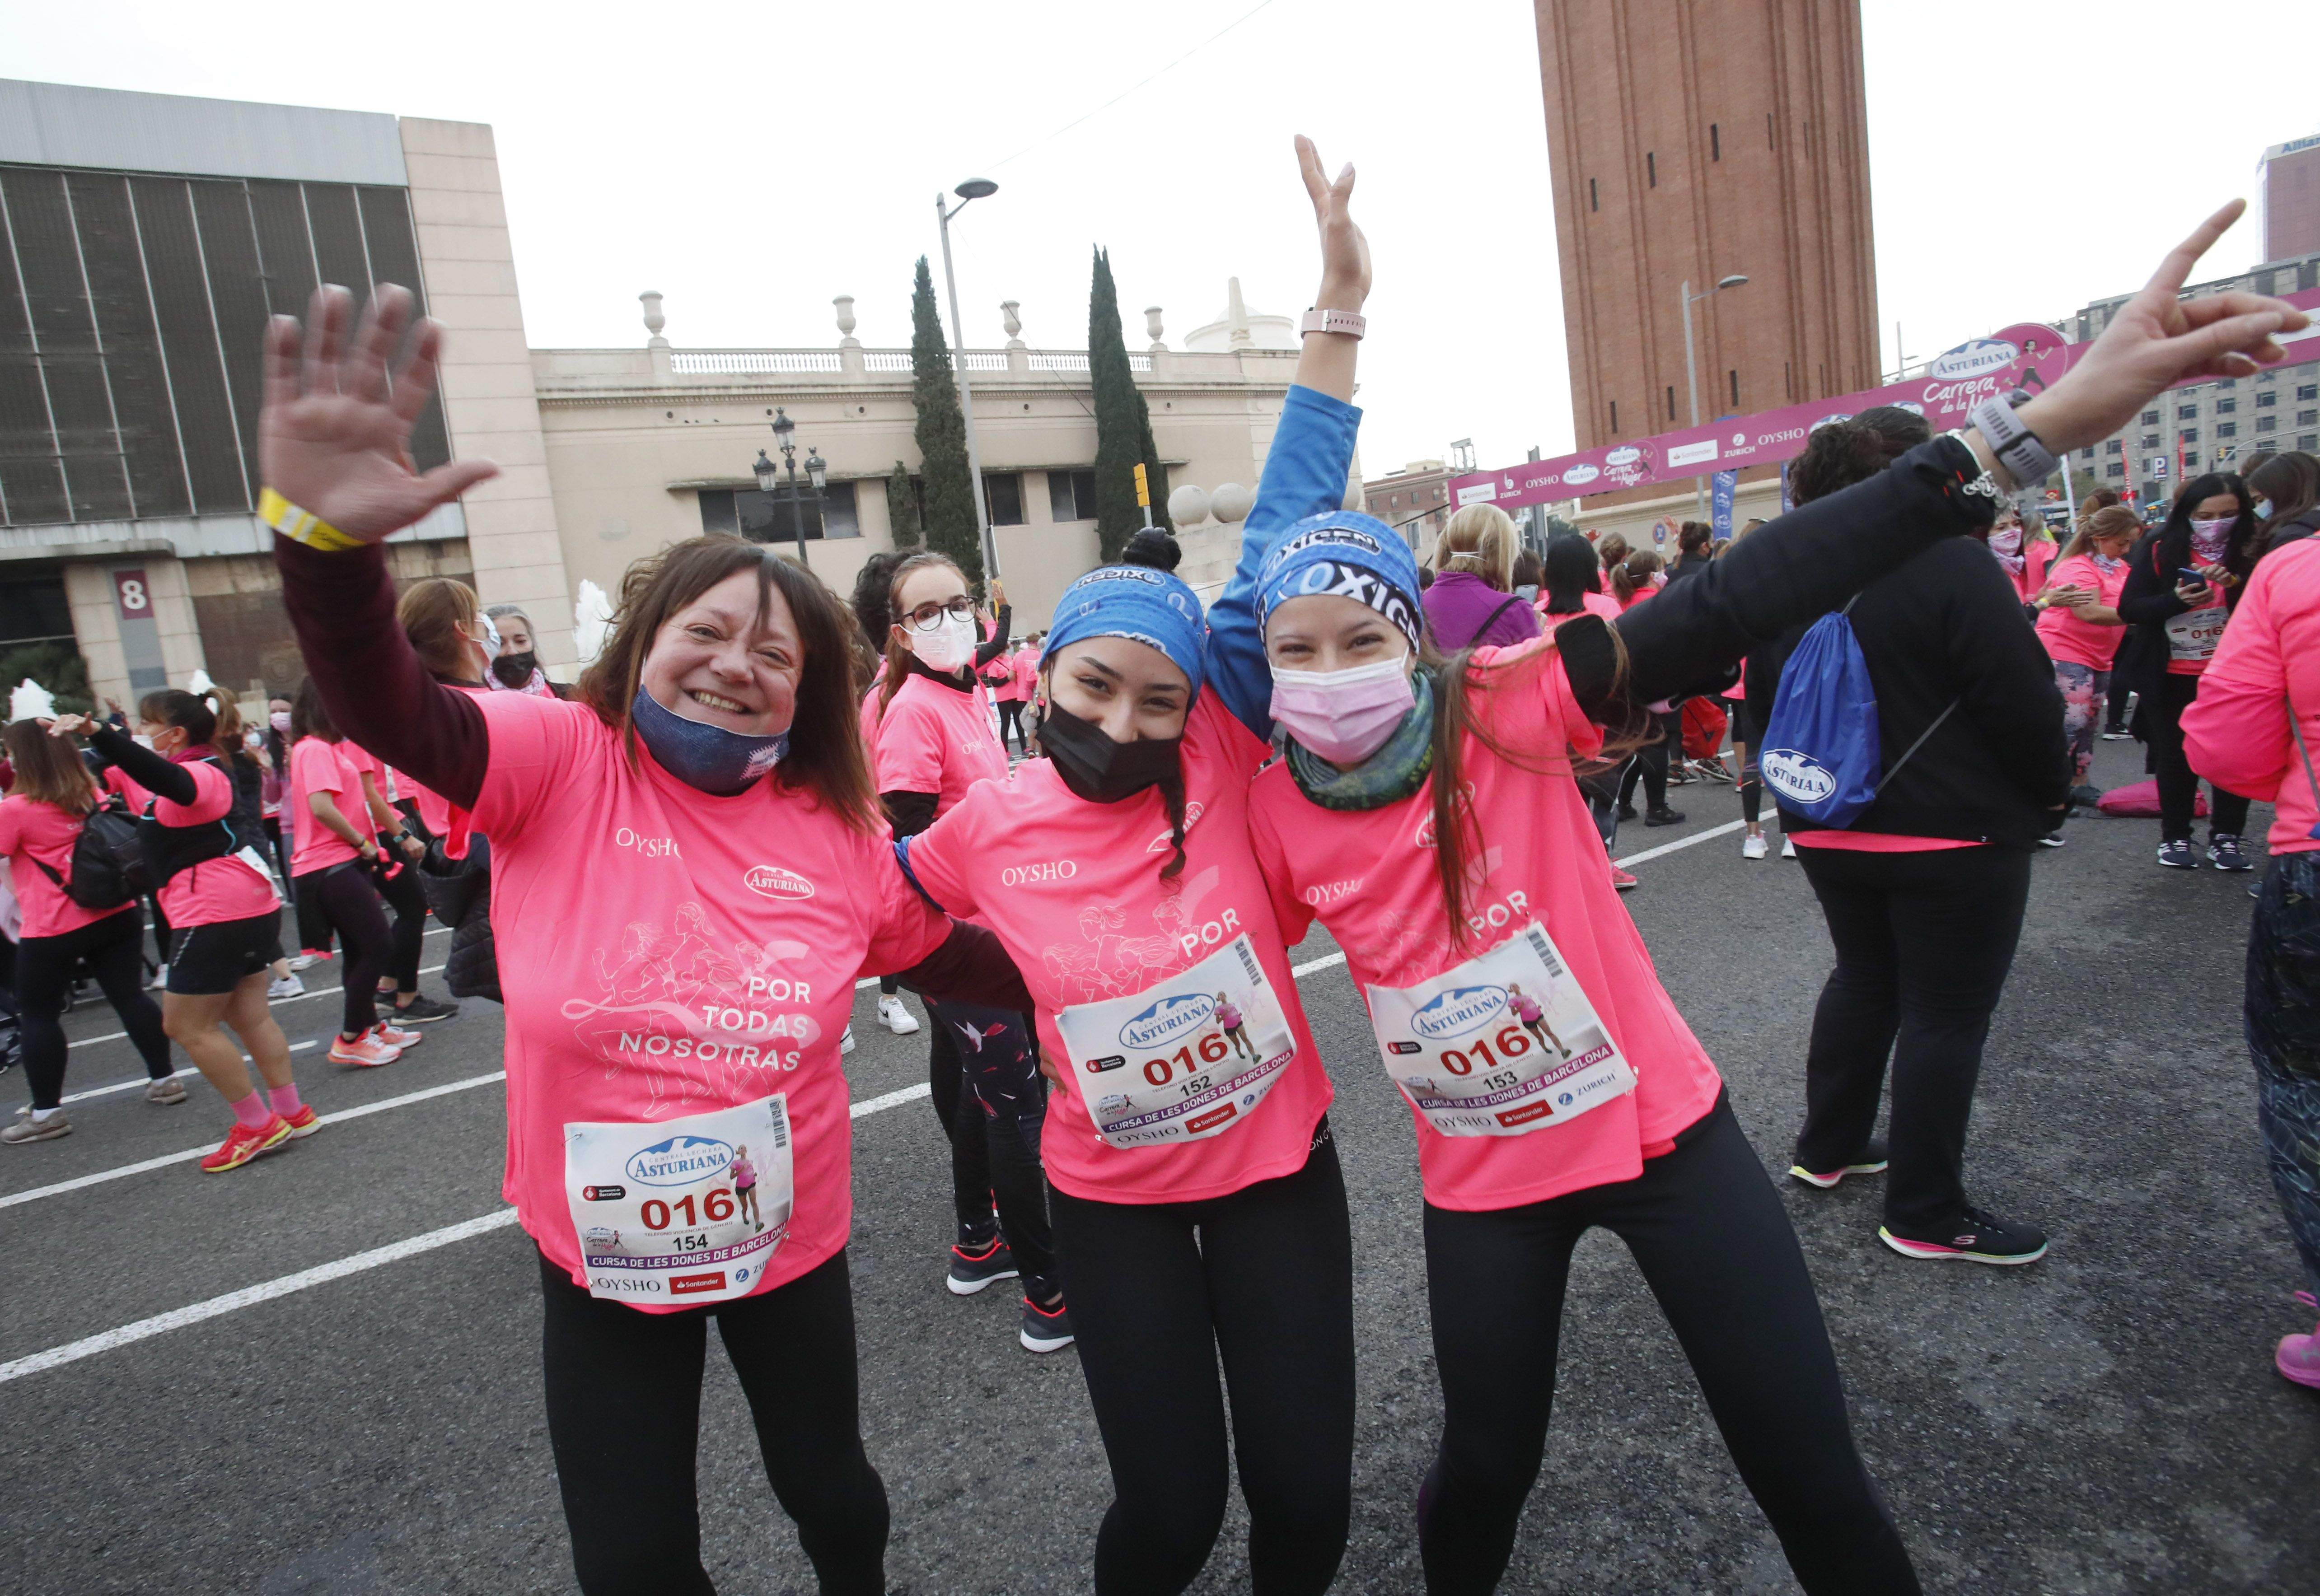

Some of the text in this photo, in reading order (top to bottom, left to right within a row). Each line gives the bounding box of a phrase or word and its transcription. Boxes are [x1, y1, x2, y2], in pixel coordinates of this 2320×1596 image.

[1938, 351, 2011, 374] ASTURIANA
[1923, 377, 1995, 403] Carrera
[1941, 401, 1953, 414] de
[1956, 398, 1967, 410] la
[1759, 428, 1805, 445] OYSHO
[1681, 448, 1712, 458] Santander
[1724, 446, 1755, 458] ZURICH
[1526, 475, 1559, 488] OYSHO
[1500, 490, 1521, 499] ZURICH
[121, 579, 147, 610] 8
[750, 872, 811, 894] ASTURIANA
[1002, 859, 1077, 887] OYSHO
[1469, 890, 1528, 940] POR
[1180, 907, 1241, 958] POR
[748, 976, 811, 1003] POR
[702, 1006, 808, 1039] TODAS
[1129, 1003, 1210, 1045] ASTURIANA
[1420, 995, 1502, 1034] ASTURIANA
[619, 1031, 801, 1071] NOSOTRAS
[1143, 1033, 1228, 1086] 016
[1440, 1026, 1530, 1075] 016
[1180, 1075, 1212, 1097] 152
[1422, 1047, 1610, 1108] CURSA DE LES DONES DE BARCELONA
[1483, 1071, 1517, 1090] 153
[1576, 1073, 1616, 1096] ZURICH
[1109, 1116, 1142, 1131] CURSA
[1145, 1113, 1160, 1123] DE
[1161, 1107, 1181, 1119] LES
[1183, 1092, 1217, 1110] DONES
[1219, 1084, 1233, 1096] DE
[1235, 1052, 1291, 1088] BARCELONA
[1201, 1109, 1230, 1126] Santander
[1435, 1115, 1491, 1128] OYSHO
[1512, 1107, 1543, 1120] Santander
[1118, 1127, 1179, 1143] OYSHO
[635, 1153, 727, 1178] ASTURIANA
[641, 1188, 734, 1230] 016
[592, 1223, 787, 1268] CURSA DE LES DONES DE BARCELONA
[673, 1234, 708, 1251] 154
[598, 1278, 660, 1292] OYSHO
[686, 1278, 719, 1289] Santander
